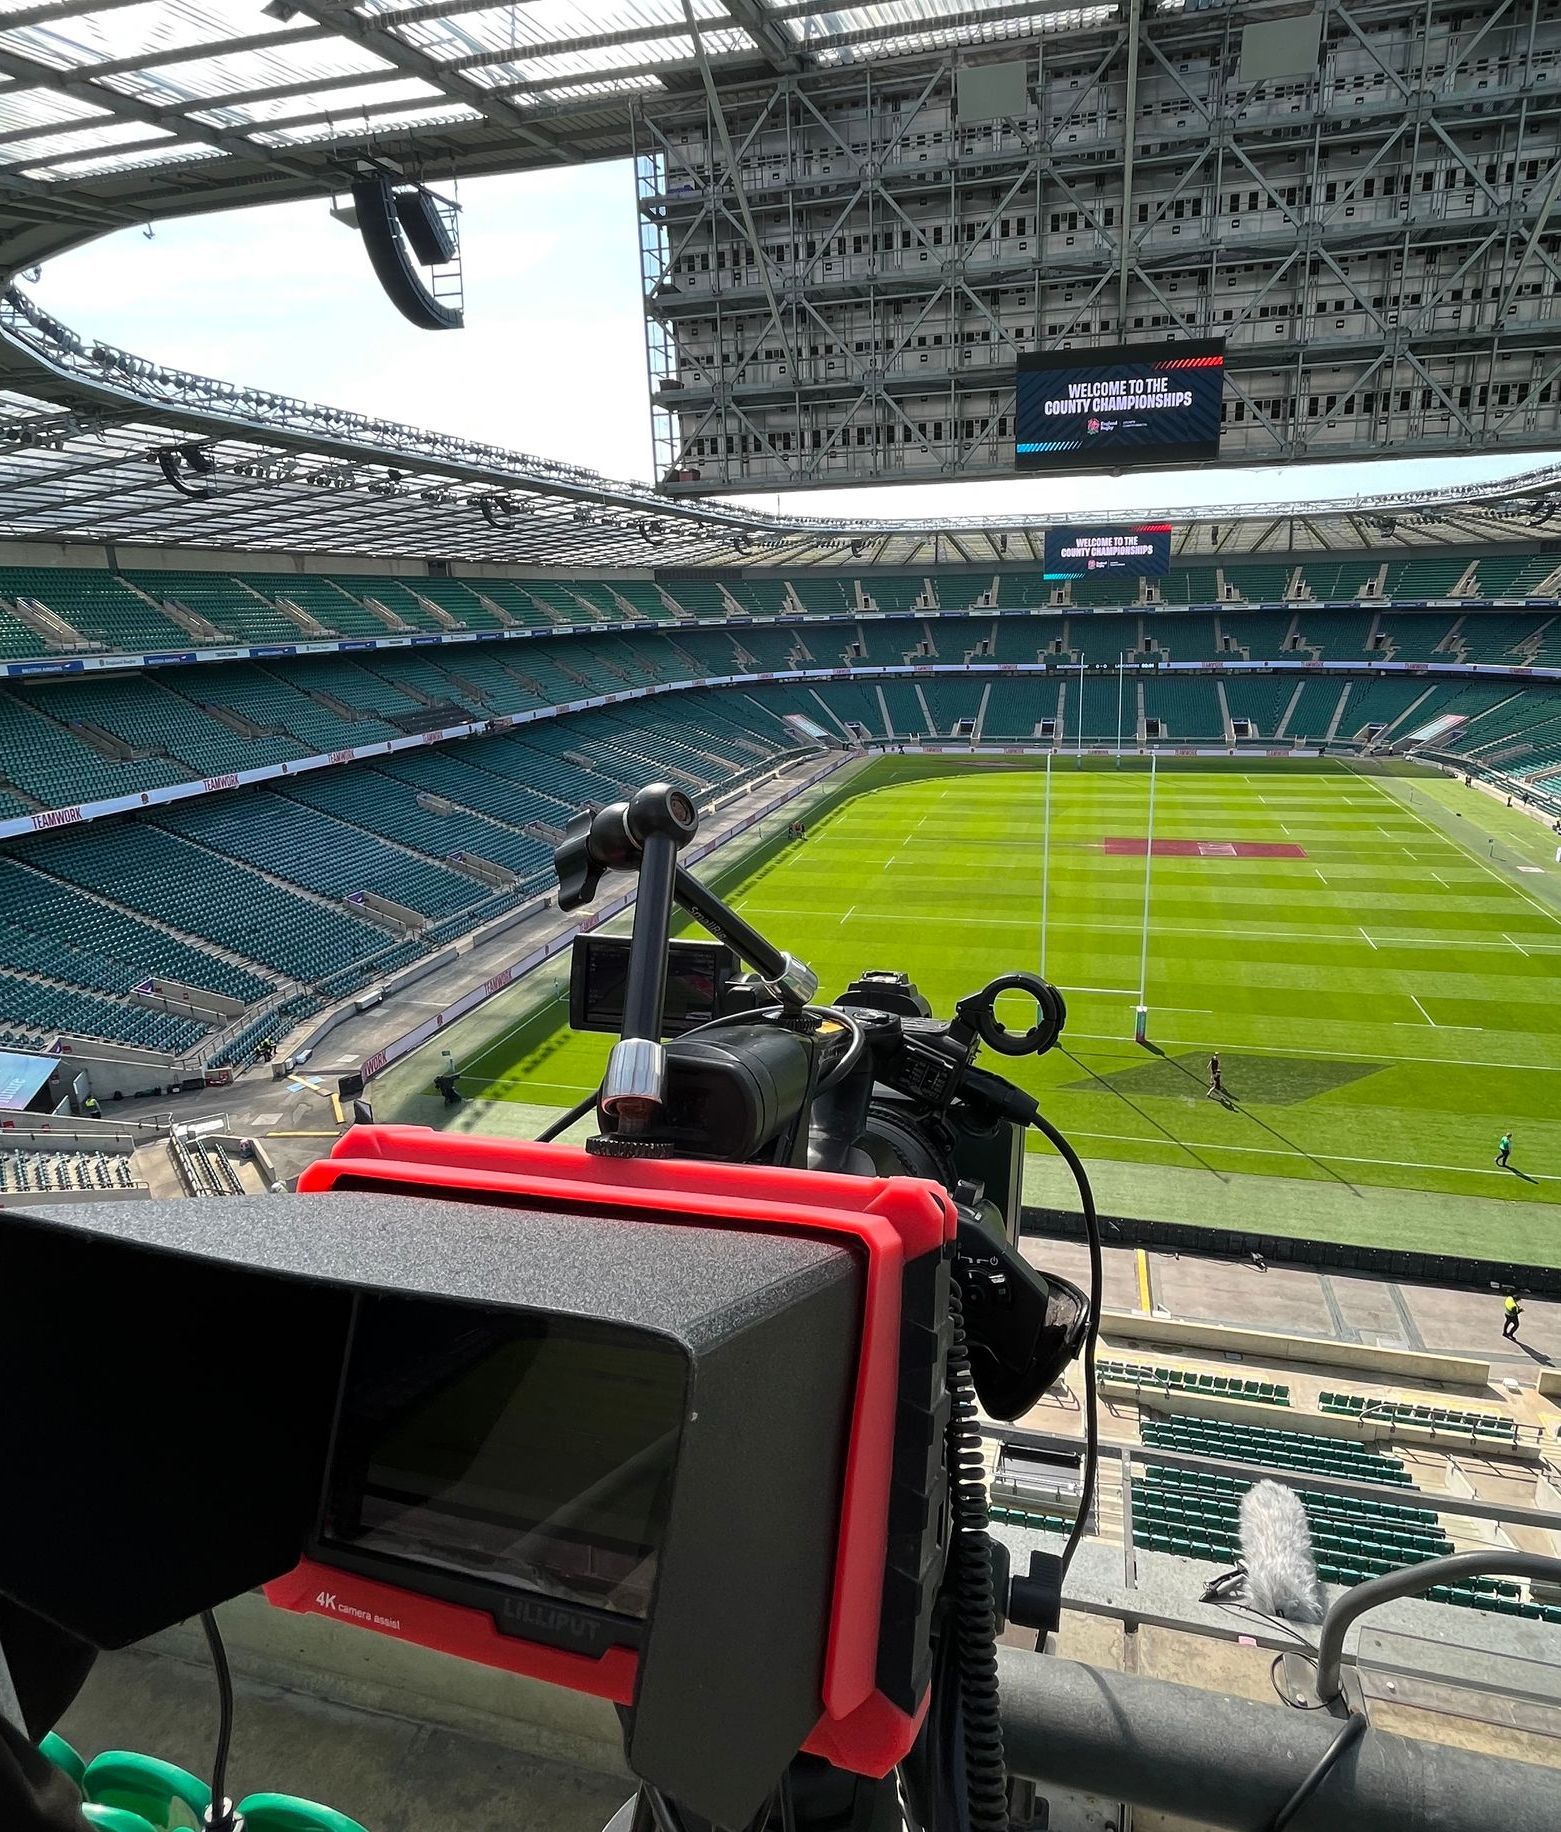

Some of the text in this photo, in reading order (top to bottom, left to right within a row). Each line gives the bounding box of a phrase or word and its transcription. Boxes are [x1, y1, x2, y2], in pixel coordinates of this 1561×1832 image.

[1068, 377, 1168, 399] WELCOME TO THE
[1044, 391, 1193, 416] COUNTY CHAMPIONSHIPS
[1060, 545, 1154, 558] COUNTY CHAMPIONSHIPS
[1075, 536, 1139, 548] WELCOME TO THE
[328, 749, 355, 764] TEAMWORK
[203, 773, 239, 791] TEAMWORK
[31, 806, 82, 830] TEAMWORK
[483, 967, 513, 996] TEAMWORK
[315, 1591, 401, 1630] 4K camera assist
[503, 1597, 601, 1641] LILLIPUT
